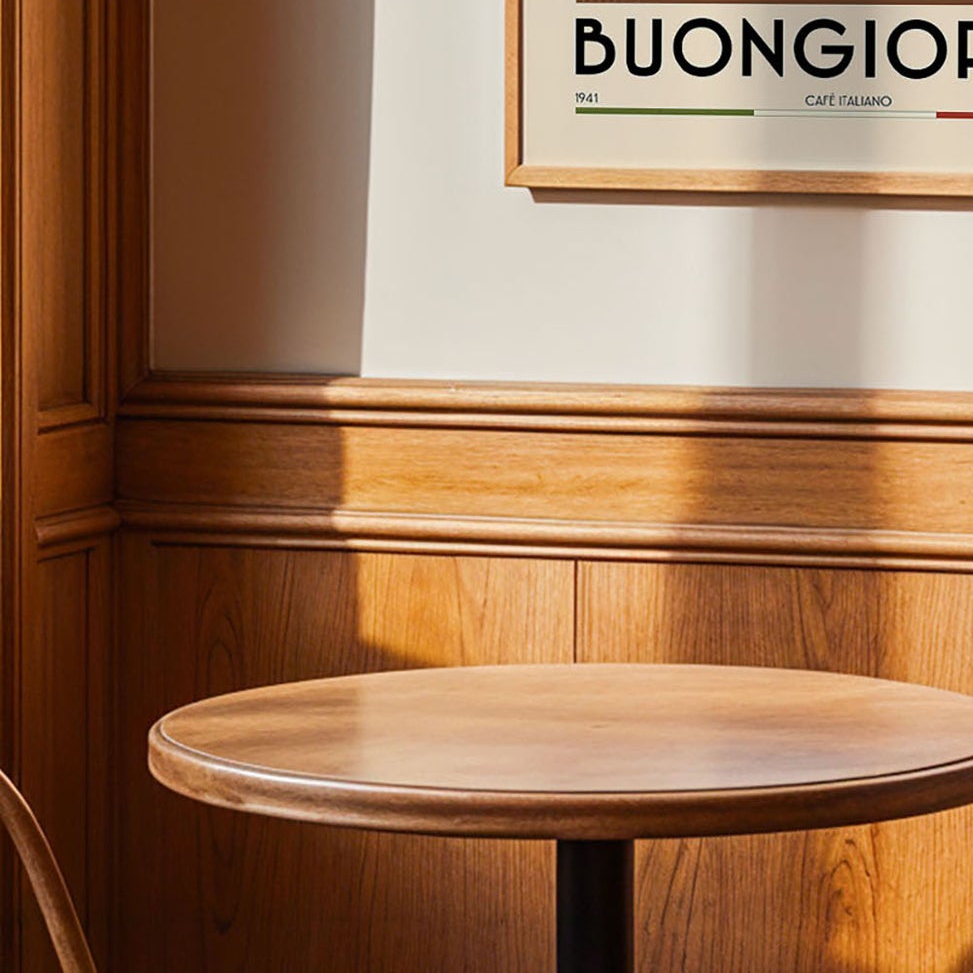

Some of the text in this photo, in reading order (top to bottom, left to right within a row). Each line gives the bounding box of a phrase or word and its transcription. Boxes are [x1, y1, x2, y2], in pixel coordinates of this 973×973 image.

[575, 93, 599, 104] 1941
[805, 93, 893, 107] CAFÉ ITALIANO
